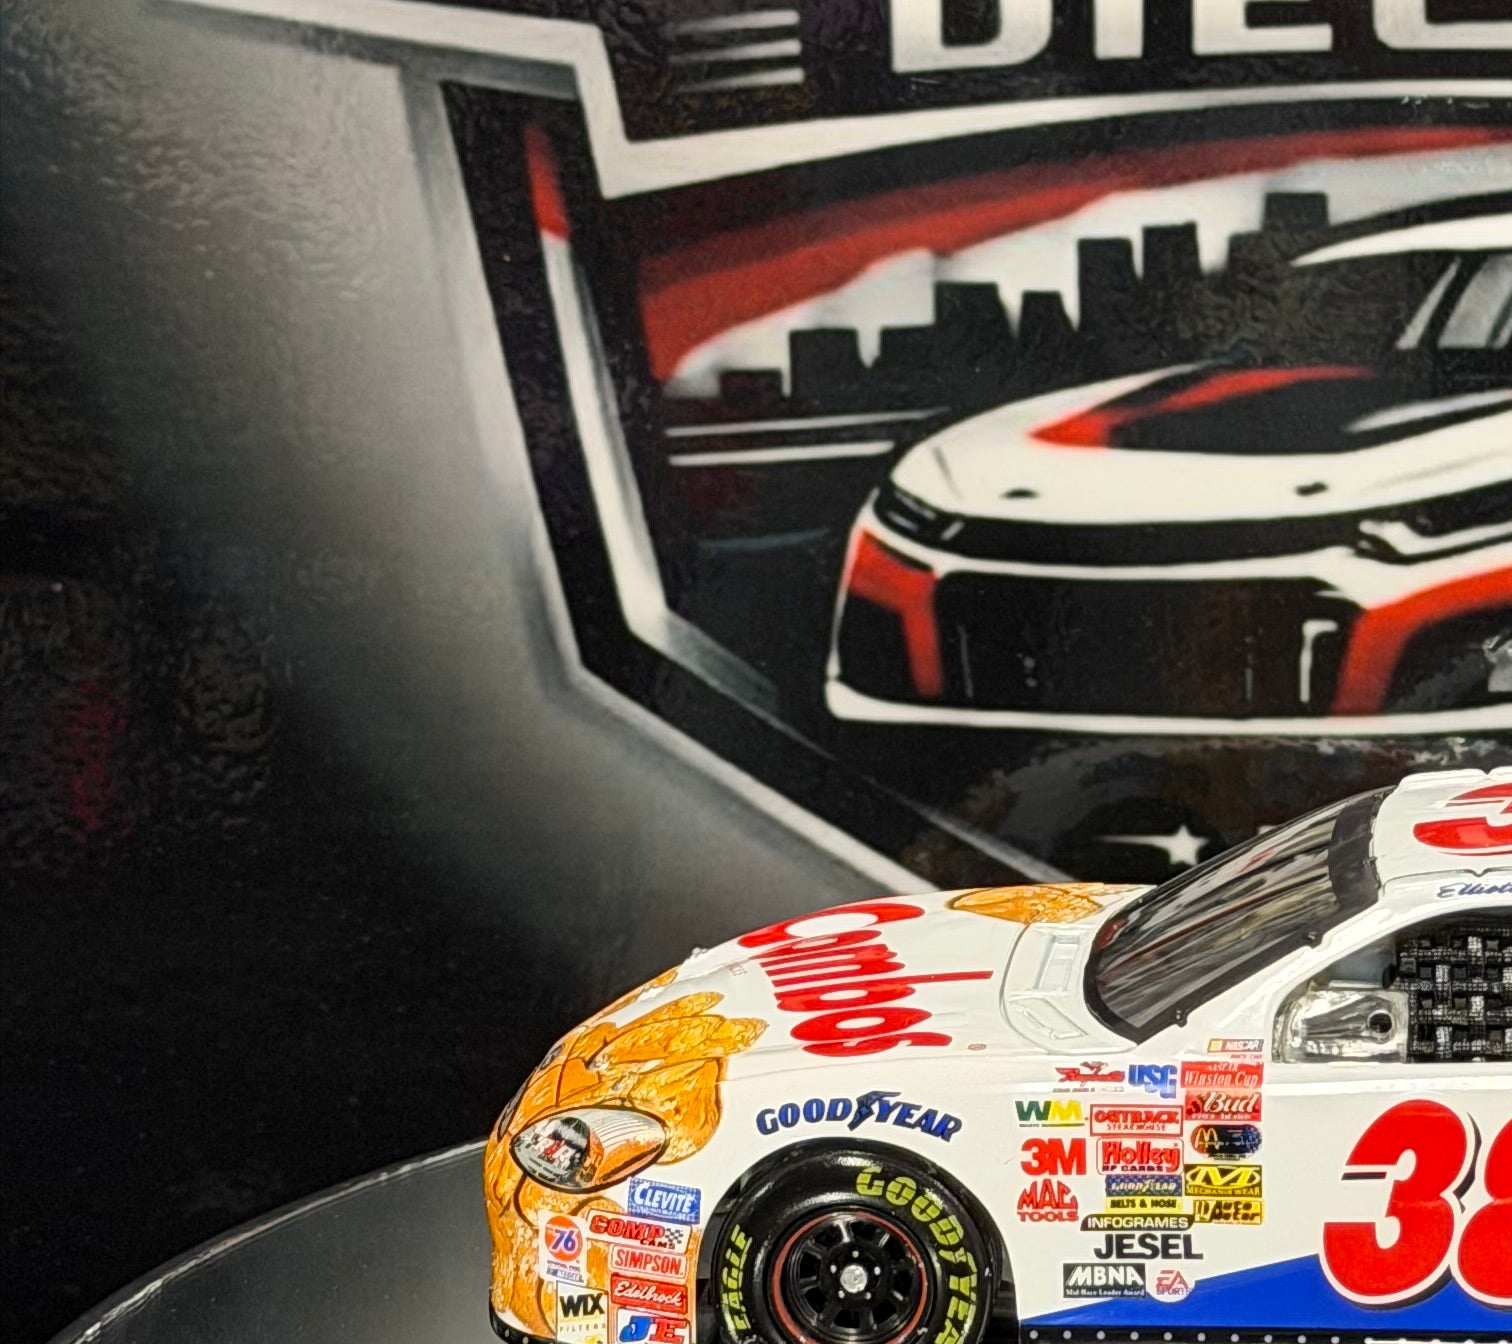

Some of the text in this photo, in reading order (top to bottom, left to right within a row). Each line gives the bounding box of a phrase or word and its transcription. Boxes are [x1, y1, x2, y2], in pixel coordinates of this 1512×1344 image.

[737, 901, 994, 1057] Combos
[1128, 1064, 1177, 1099] USG
[755, 1090, 963, 1143] GOODYEAR
[1203, 1091, 1260, 1114] Bud
[1020, 1137, 1088, 1176] 3M
[1102, 1140, 1180, 1169] Holley
[634, 1181, 694, 1213] CLEVITE
[1017, 1178, 1079, 1210] MAC
[590, 1214, 665, 1243] COMP
[1018, 1210, 1079, 1223] TOOLS
[1087, 1216, 1189, 1230] INFOGRAMES
[550, 1228, 577, 1253] 76
[1093, 1233, 1204, 1260] JESEL
[614, 1248, 682, 1276] SIMPSON
[1065, 1265, 1145, 1287] MBNA
[721, 1223, 753, 1331] EAGLE
[1156, 1269, 1189, 1288] EA
[559, 1292, 605, 1318] WIX
[614, 1280, 683, 1306] Edelbrock
